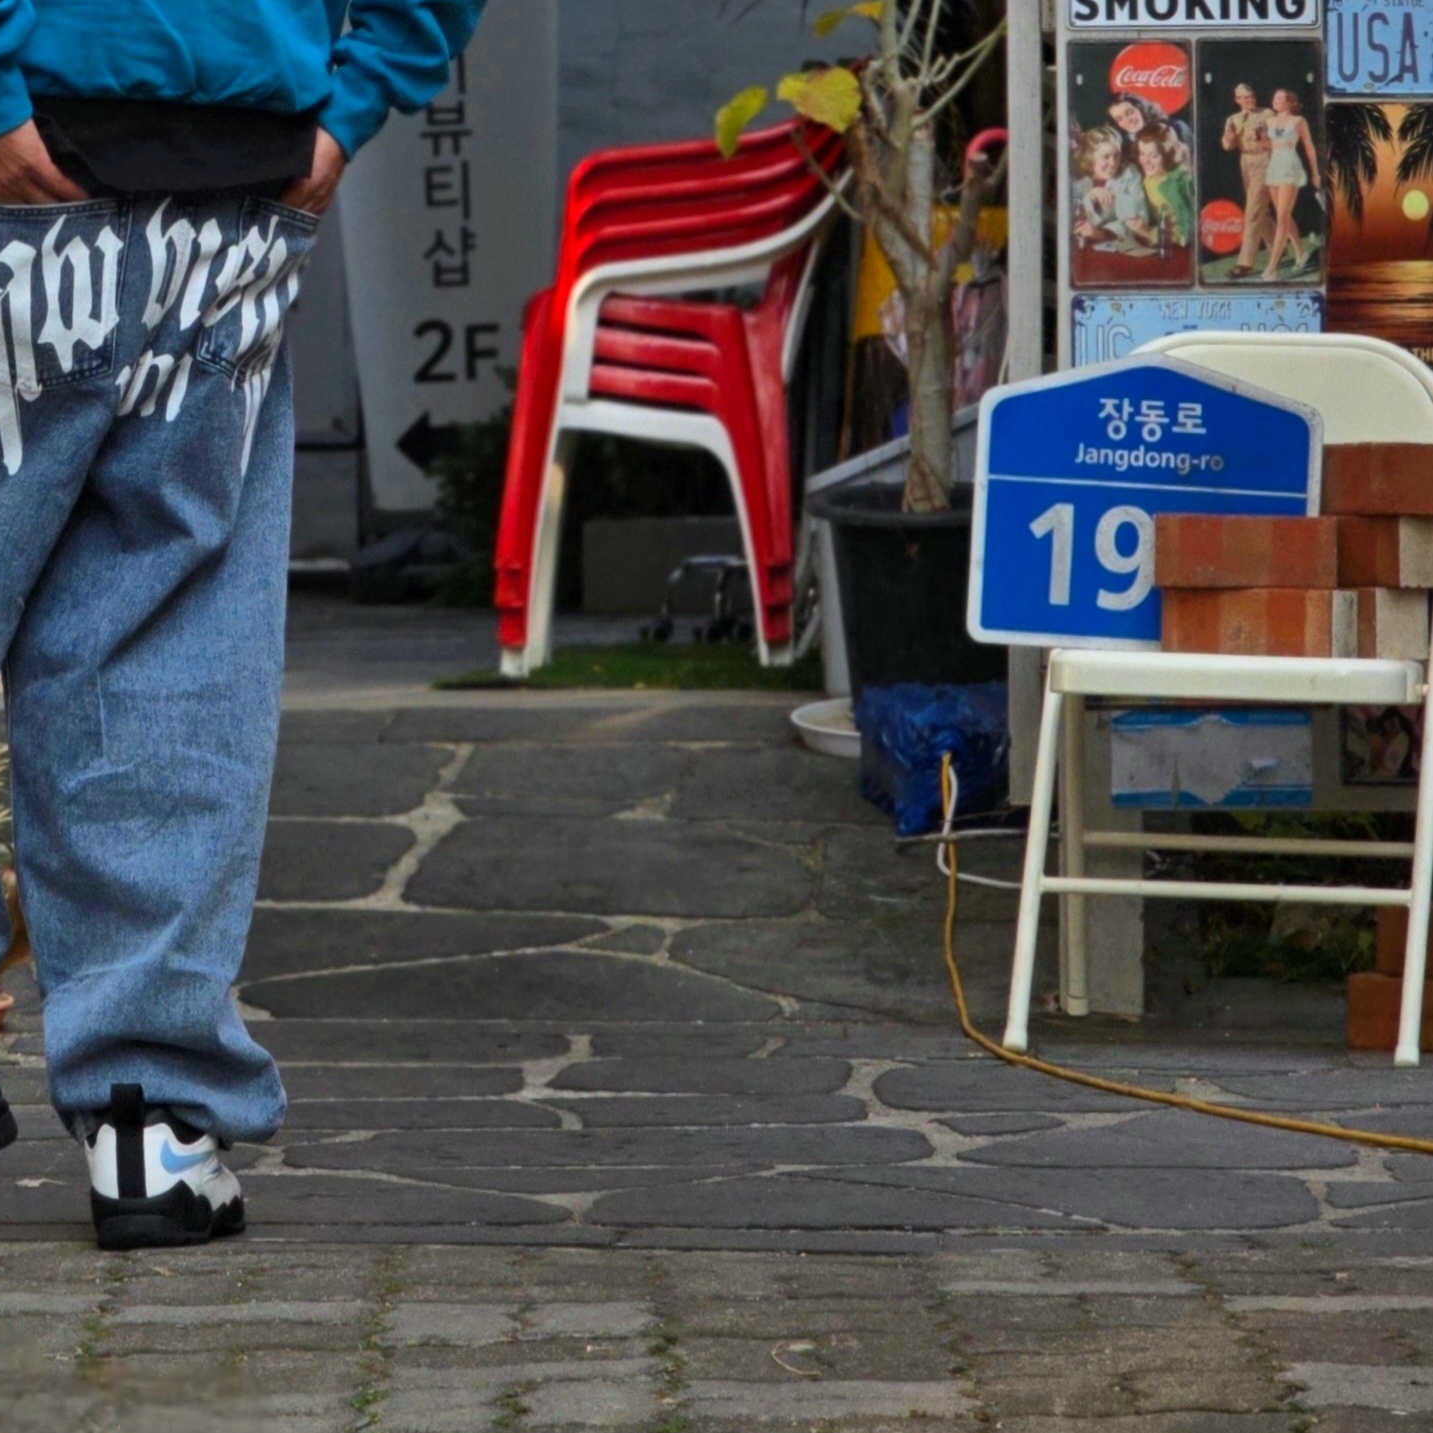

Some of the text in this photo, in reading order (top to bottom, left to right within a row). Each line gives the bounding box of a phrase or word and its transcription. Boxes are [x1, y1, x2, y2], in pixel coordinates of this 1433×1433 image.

[1337, 11, 1420, 84] USA
[413, 319, 499, 385] 2F
[1098, 398, 1208, 443] 장동로
[1074, 442, 1225, 476] Jangdong-ro
[1028, 502, 1156, 611] 19
